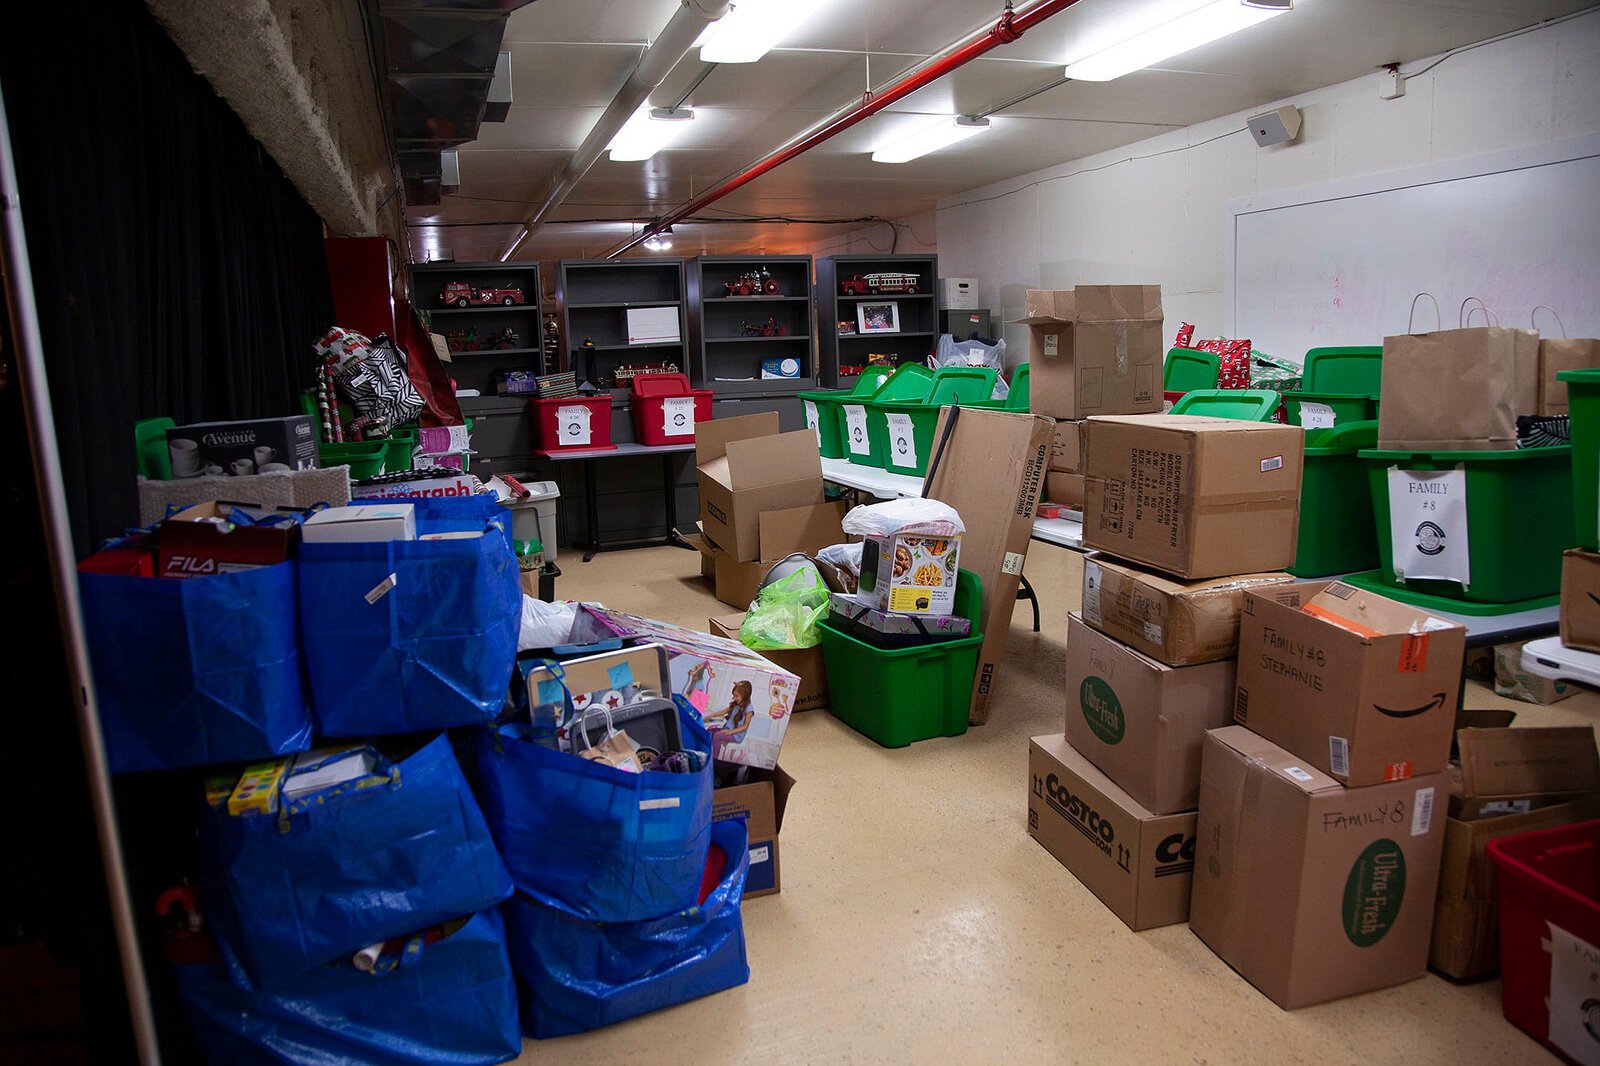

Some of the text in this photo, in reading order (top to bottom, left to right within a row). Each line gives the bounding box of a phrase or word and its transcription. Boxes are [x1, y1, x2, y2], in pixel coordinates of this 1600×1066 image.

[202, 432, 256, 446] Avenue
[1130, 448, 1138, 478] CARTON
[1166, 453, 1174, 480] MODEL
[1023, 444, 1047, 519] COMPUTER DESK
[1408, 482, 1449, 494] FAMILY
[1143, 495, 1150, 507] KG
[1150, 497, 1157, 508] KG
[1169, 523, 1178, 548] FRYER
[166, 555, 215, 573] FILA
[1260, 653, 1323, 692] STEPHANIE
[1046, 773, 1115, 843] COSTCO
[1322, 799, 1405, 833] FAMILY 8
[1360, 851, 1400, 935] Ultra-Fresh
